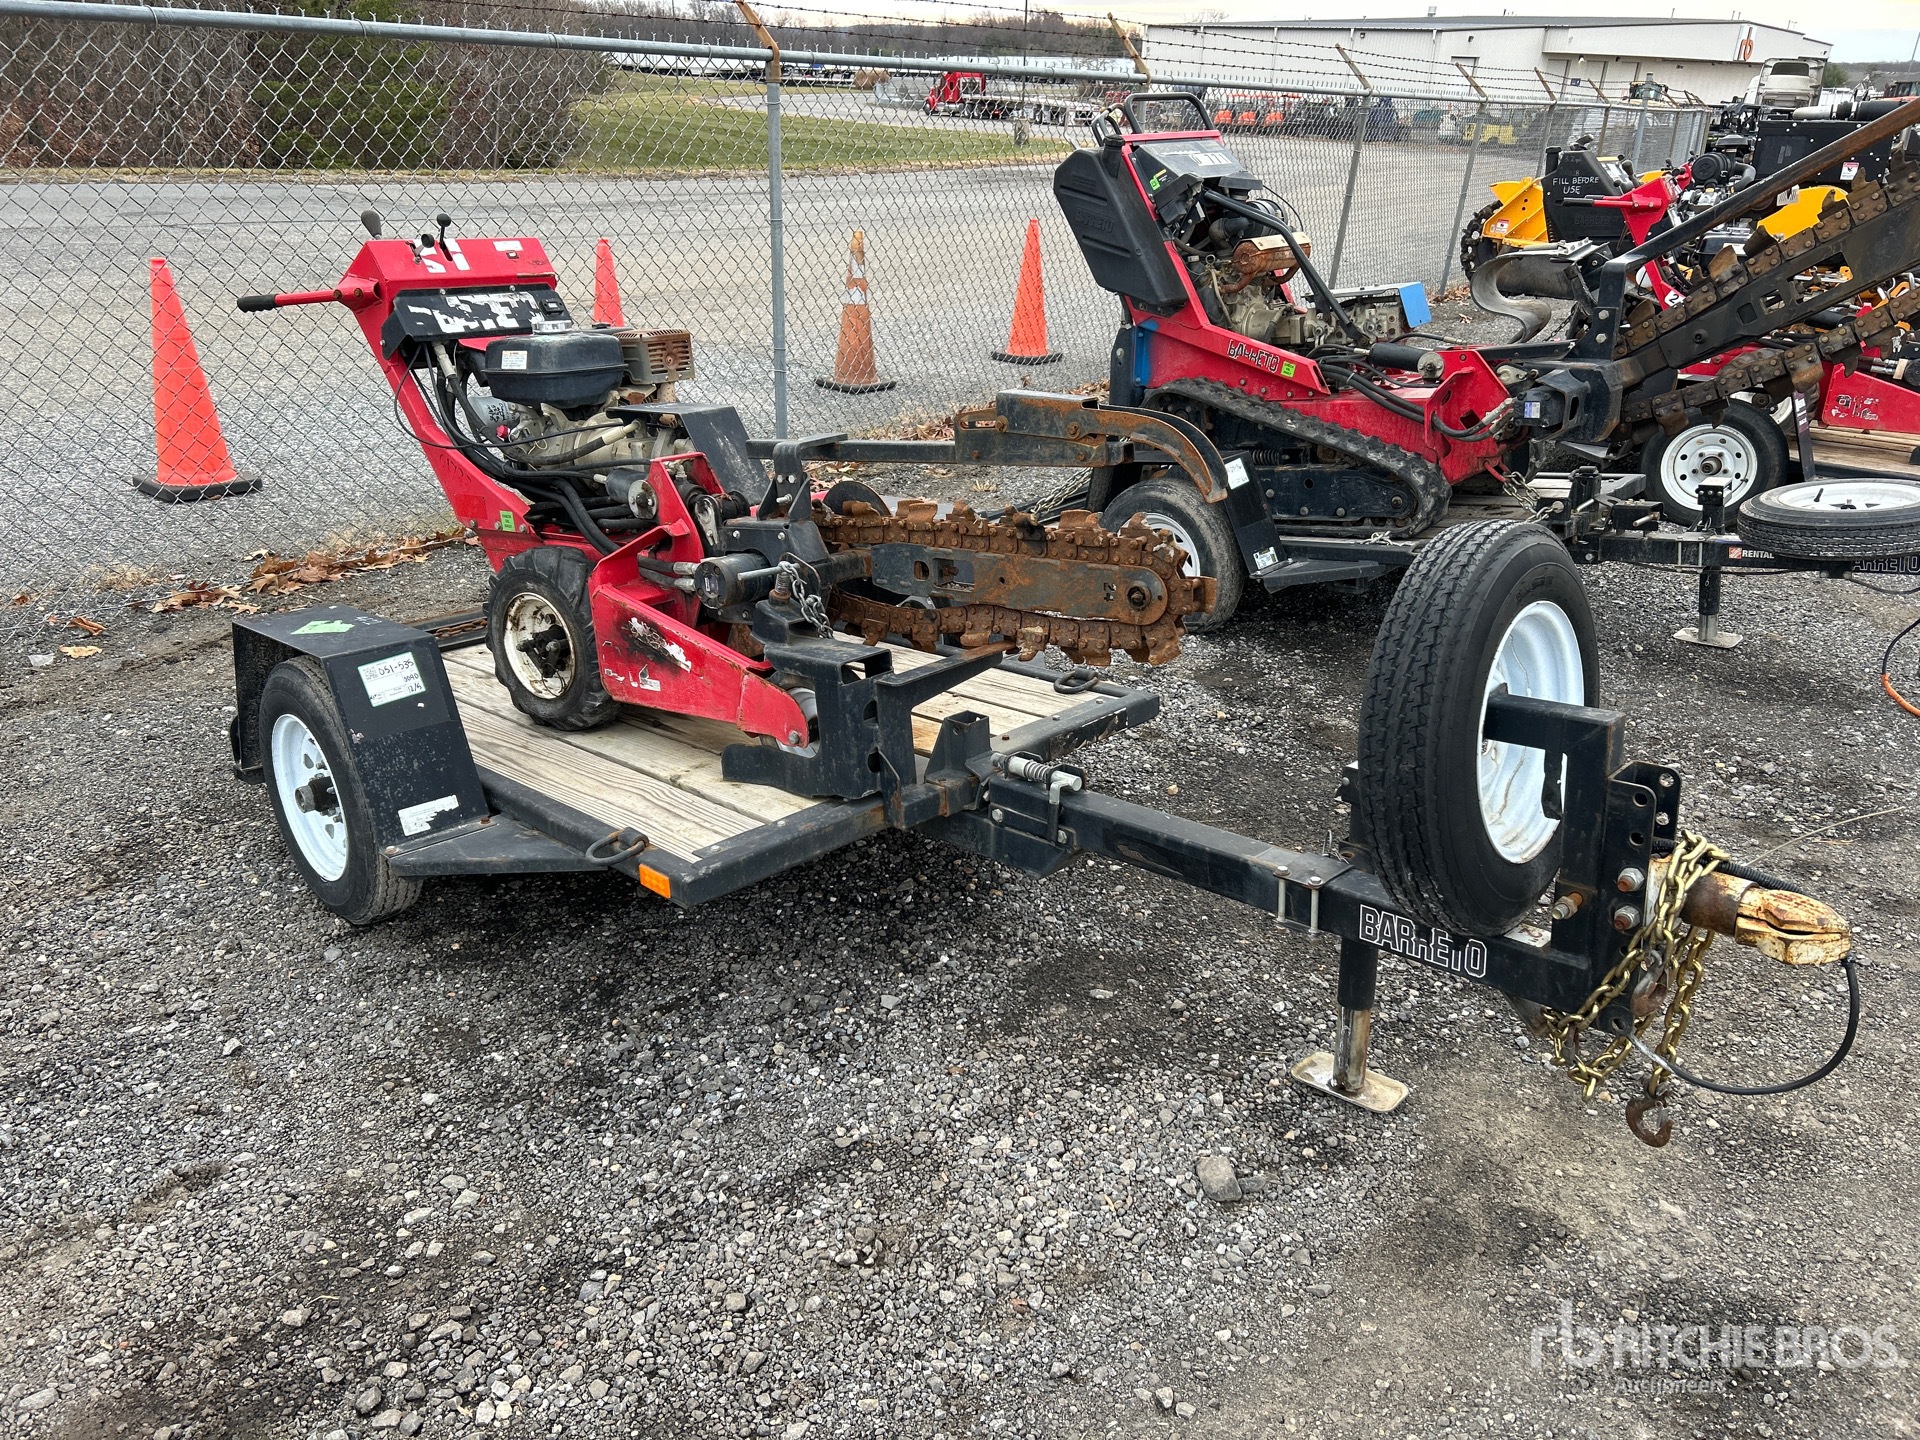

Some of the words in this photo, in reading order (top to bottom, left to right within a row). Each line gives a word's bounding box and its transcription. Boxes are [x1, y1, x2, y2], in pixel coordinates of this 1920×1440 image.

[1552, 177, 1569, 186] FILL
[1572, 176, 1599, 185] BEFORE
[1563, 186, 1581, 195] USE
[1742, 549, 1775, 559] RENTAL
